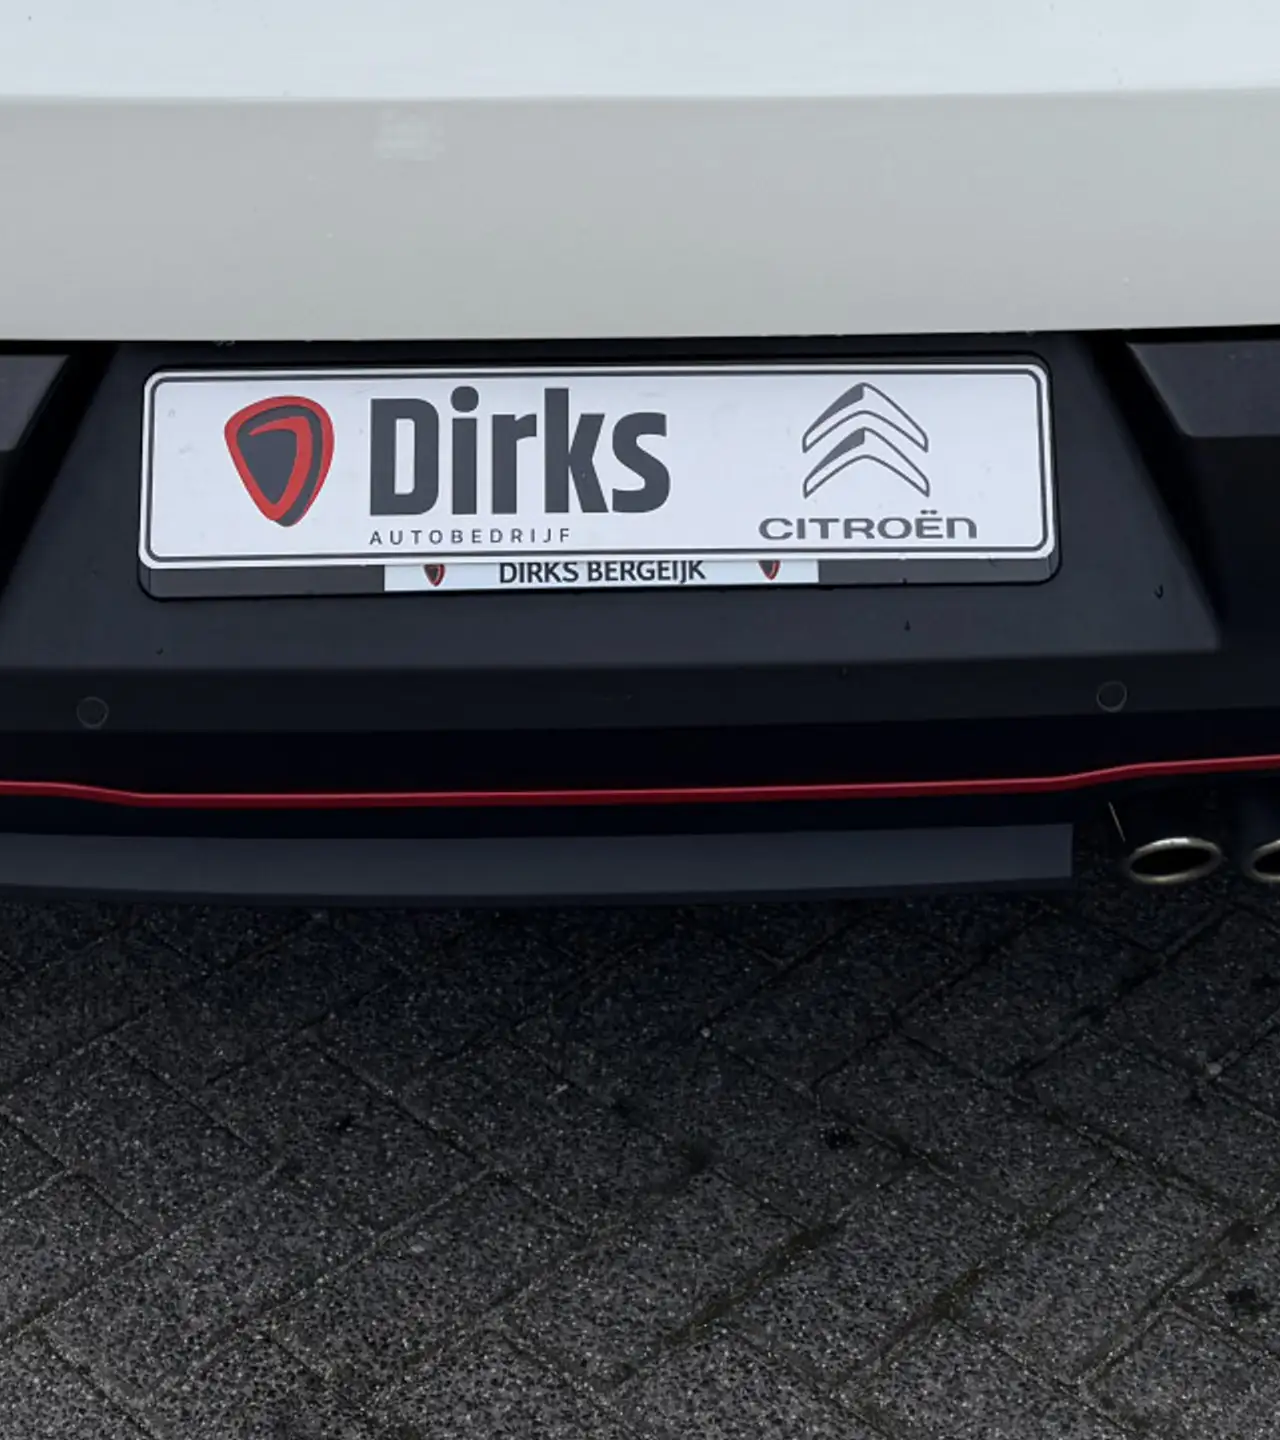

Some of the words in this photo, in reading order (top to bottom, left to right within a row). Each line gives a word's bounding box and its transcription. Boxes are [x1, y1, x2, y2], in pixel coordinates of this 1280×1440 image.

[370, 385, 671, 516] Dirks
[369, 527, 570, 545] AUTOBEDRIJF
[499, 560, 579, 584] DIRKS
[587, 560, 707, 585] BERGEIJK
